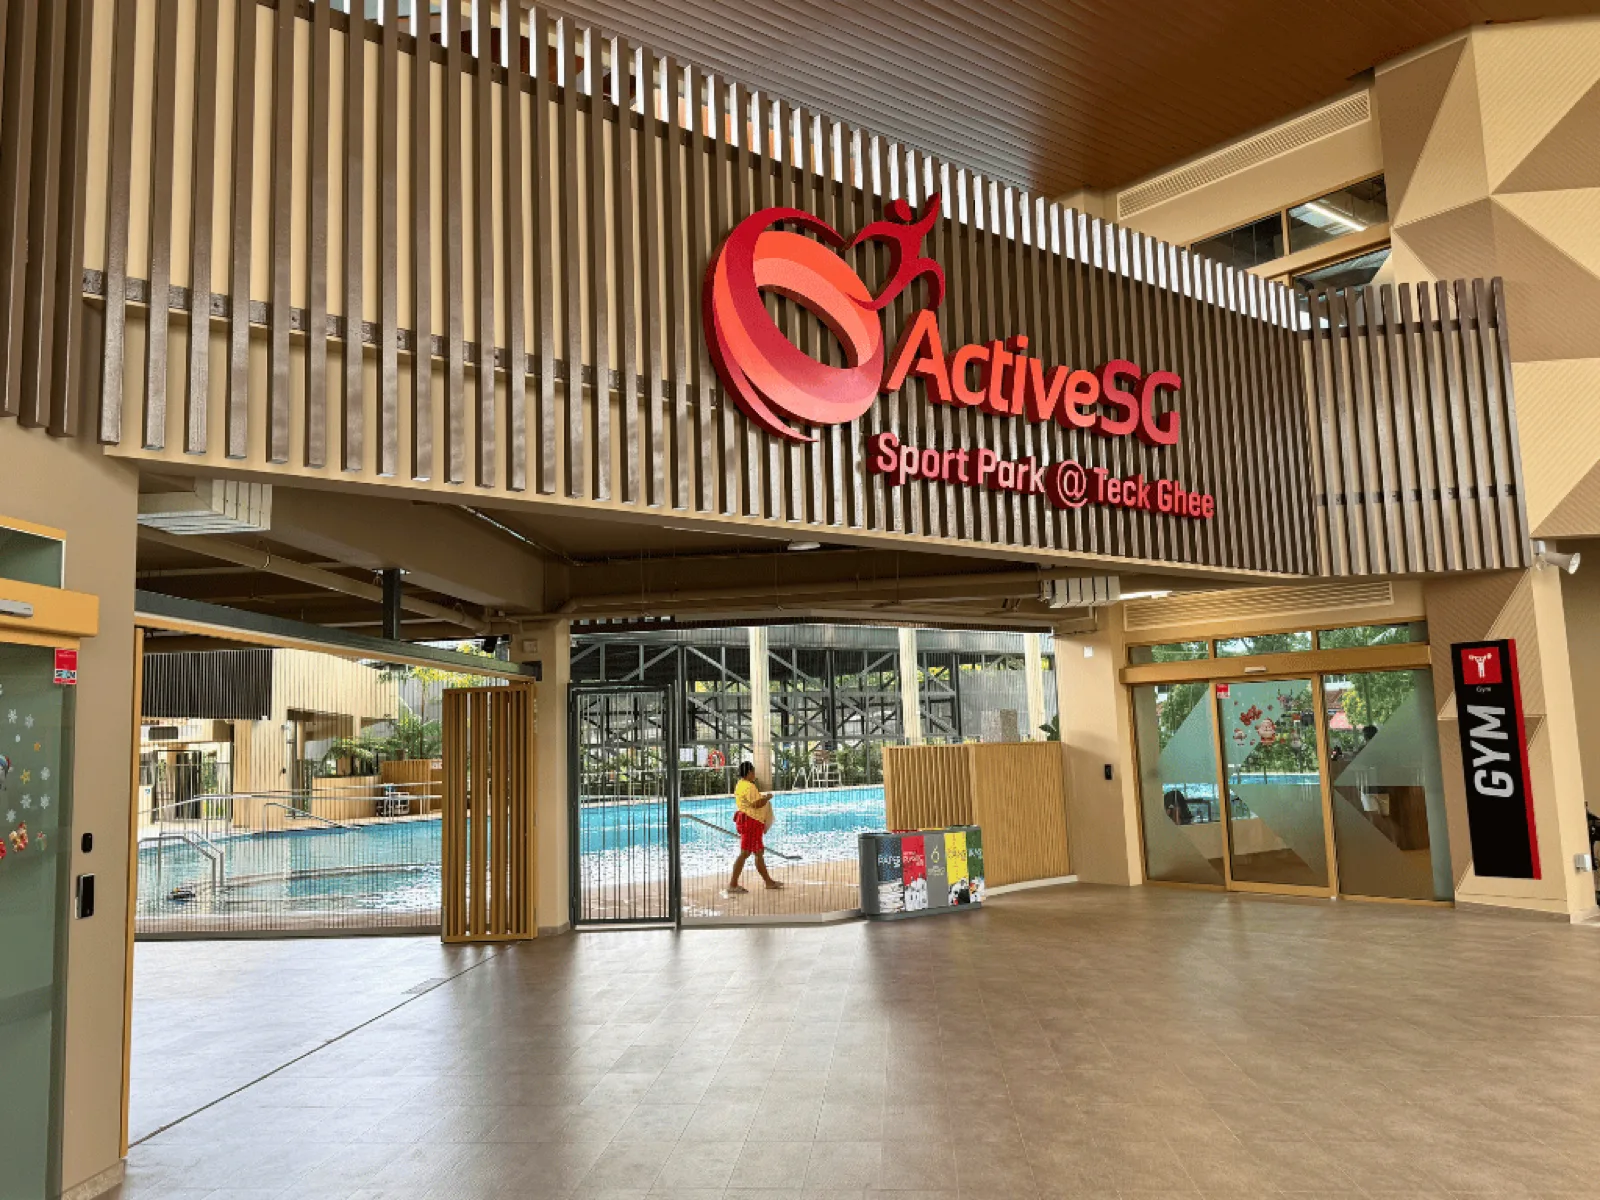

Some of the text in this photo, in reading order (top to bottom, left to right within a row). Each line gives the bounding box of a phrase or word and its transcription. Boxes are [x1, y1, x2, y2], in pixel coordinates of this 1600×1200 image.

[884, 308, 1181, 446] ActiveSG
[875, 432, 1215, 518] Sport Park @ Teck Ghee
[1466, 704, 1515, 798] GYM
